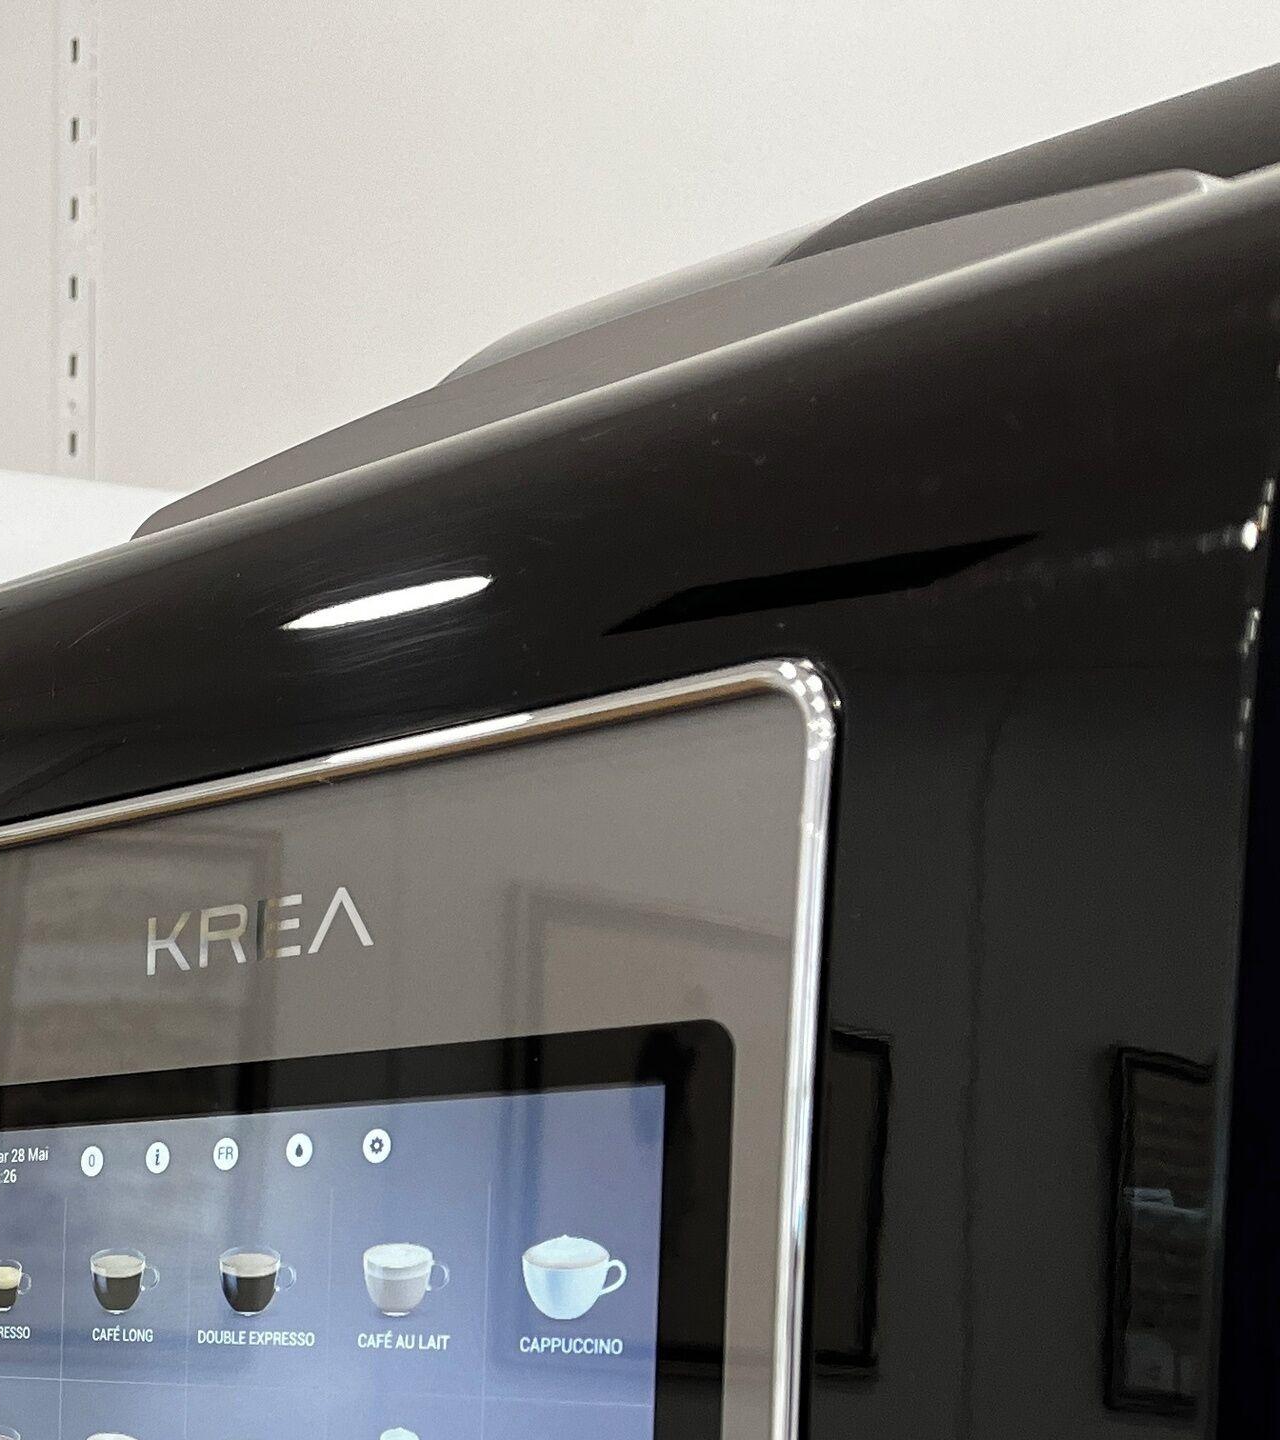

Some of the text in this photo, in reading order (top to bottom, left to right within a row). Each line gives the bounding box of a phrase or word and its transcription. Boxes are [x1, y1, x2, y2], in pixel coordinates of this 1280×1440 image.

[11, 1148, 26, 1163] 28
[28, 1145, 49, 1162] Mai
[217, 1146, 234, 1160] FR
[92, 1325, 153, 1343] CAFÉ LONG
[197, 1329, 315, 1347] DOUBLE EXPRESSO
[357, 1330, 451, 1350] CAFÉ AU LAIT
[519, 1336, 624, 1355] CAPPUCCINO
